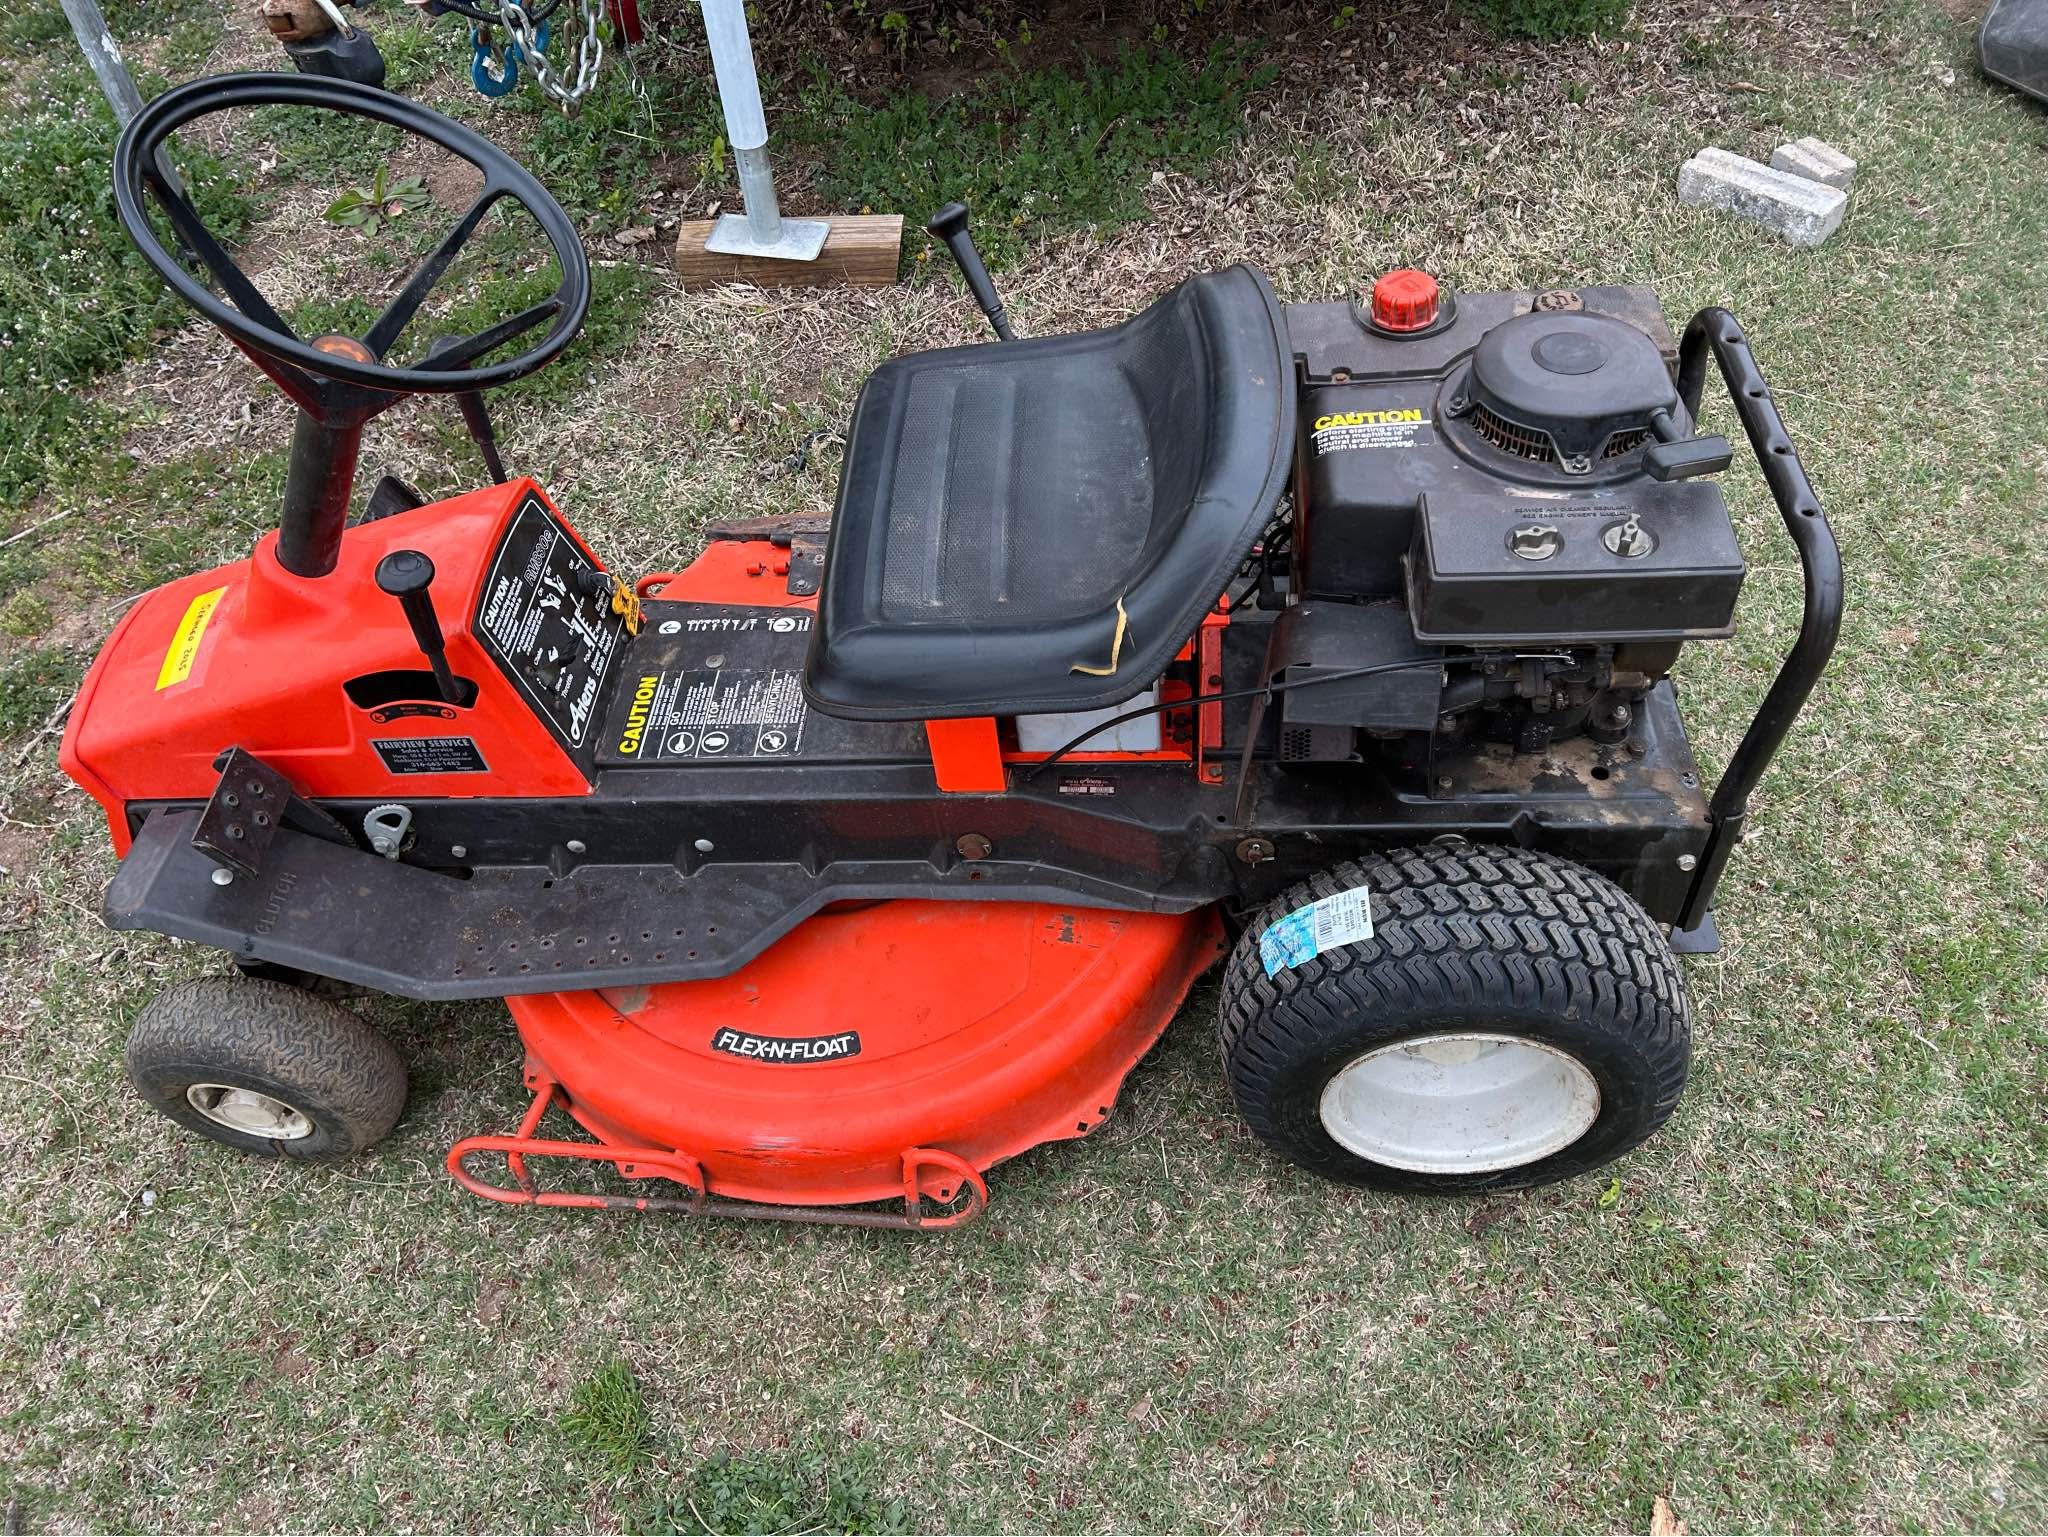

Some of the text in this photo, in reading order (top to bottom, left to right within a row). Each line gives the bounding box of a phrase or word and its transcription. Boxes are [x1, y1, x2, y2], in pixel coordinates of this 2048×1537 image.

[1315, 409, 1422, 430] CAUTION
[1317, 424, 1418, 439] Before starting engine
[1317, 436, 1328, 444] be
[1318, 439, 1350, 450] neutral
[1318, 444, 1347, 455] clutch
[485, 575, 509, 629] CAUTION
[538, 586, 544, 597] On
[595, 589, 606, 613] Engine
[598, 627, 608, 649] Mower
[603, 633, 613, 656] Height
[534, 645, 543, 666] Choke
[591, 648, 600, 671] Mower
[595, 655, 605, 677] Clutch
[561, 672, 573, 700] Throttle
[569, 676, 596, 741] Ariens
[764, 678, 783, 723] SERVICING
[619, 676, 658, 753] CAUTION
[670, 712, 681, 726] GO
[707, 701, 720, 725] STOP
[378, 739, 470, 749] FAIRVIEW SERVICE
[718, 1032, 850, 1059] FLEX-N-FLOAT
